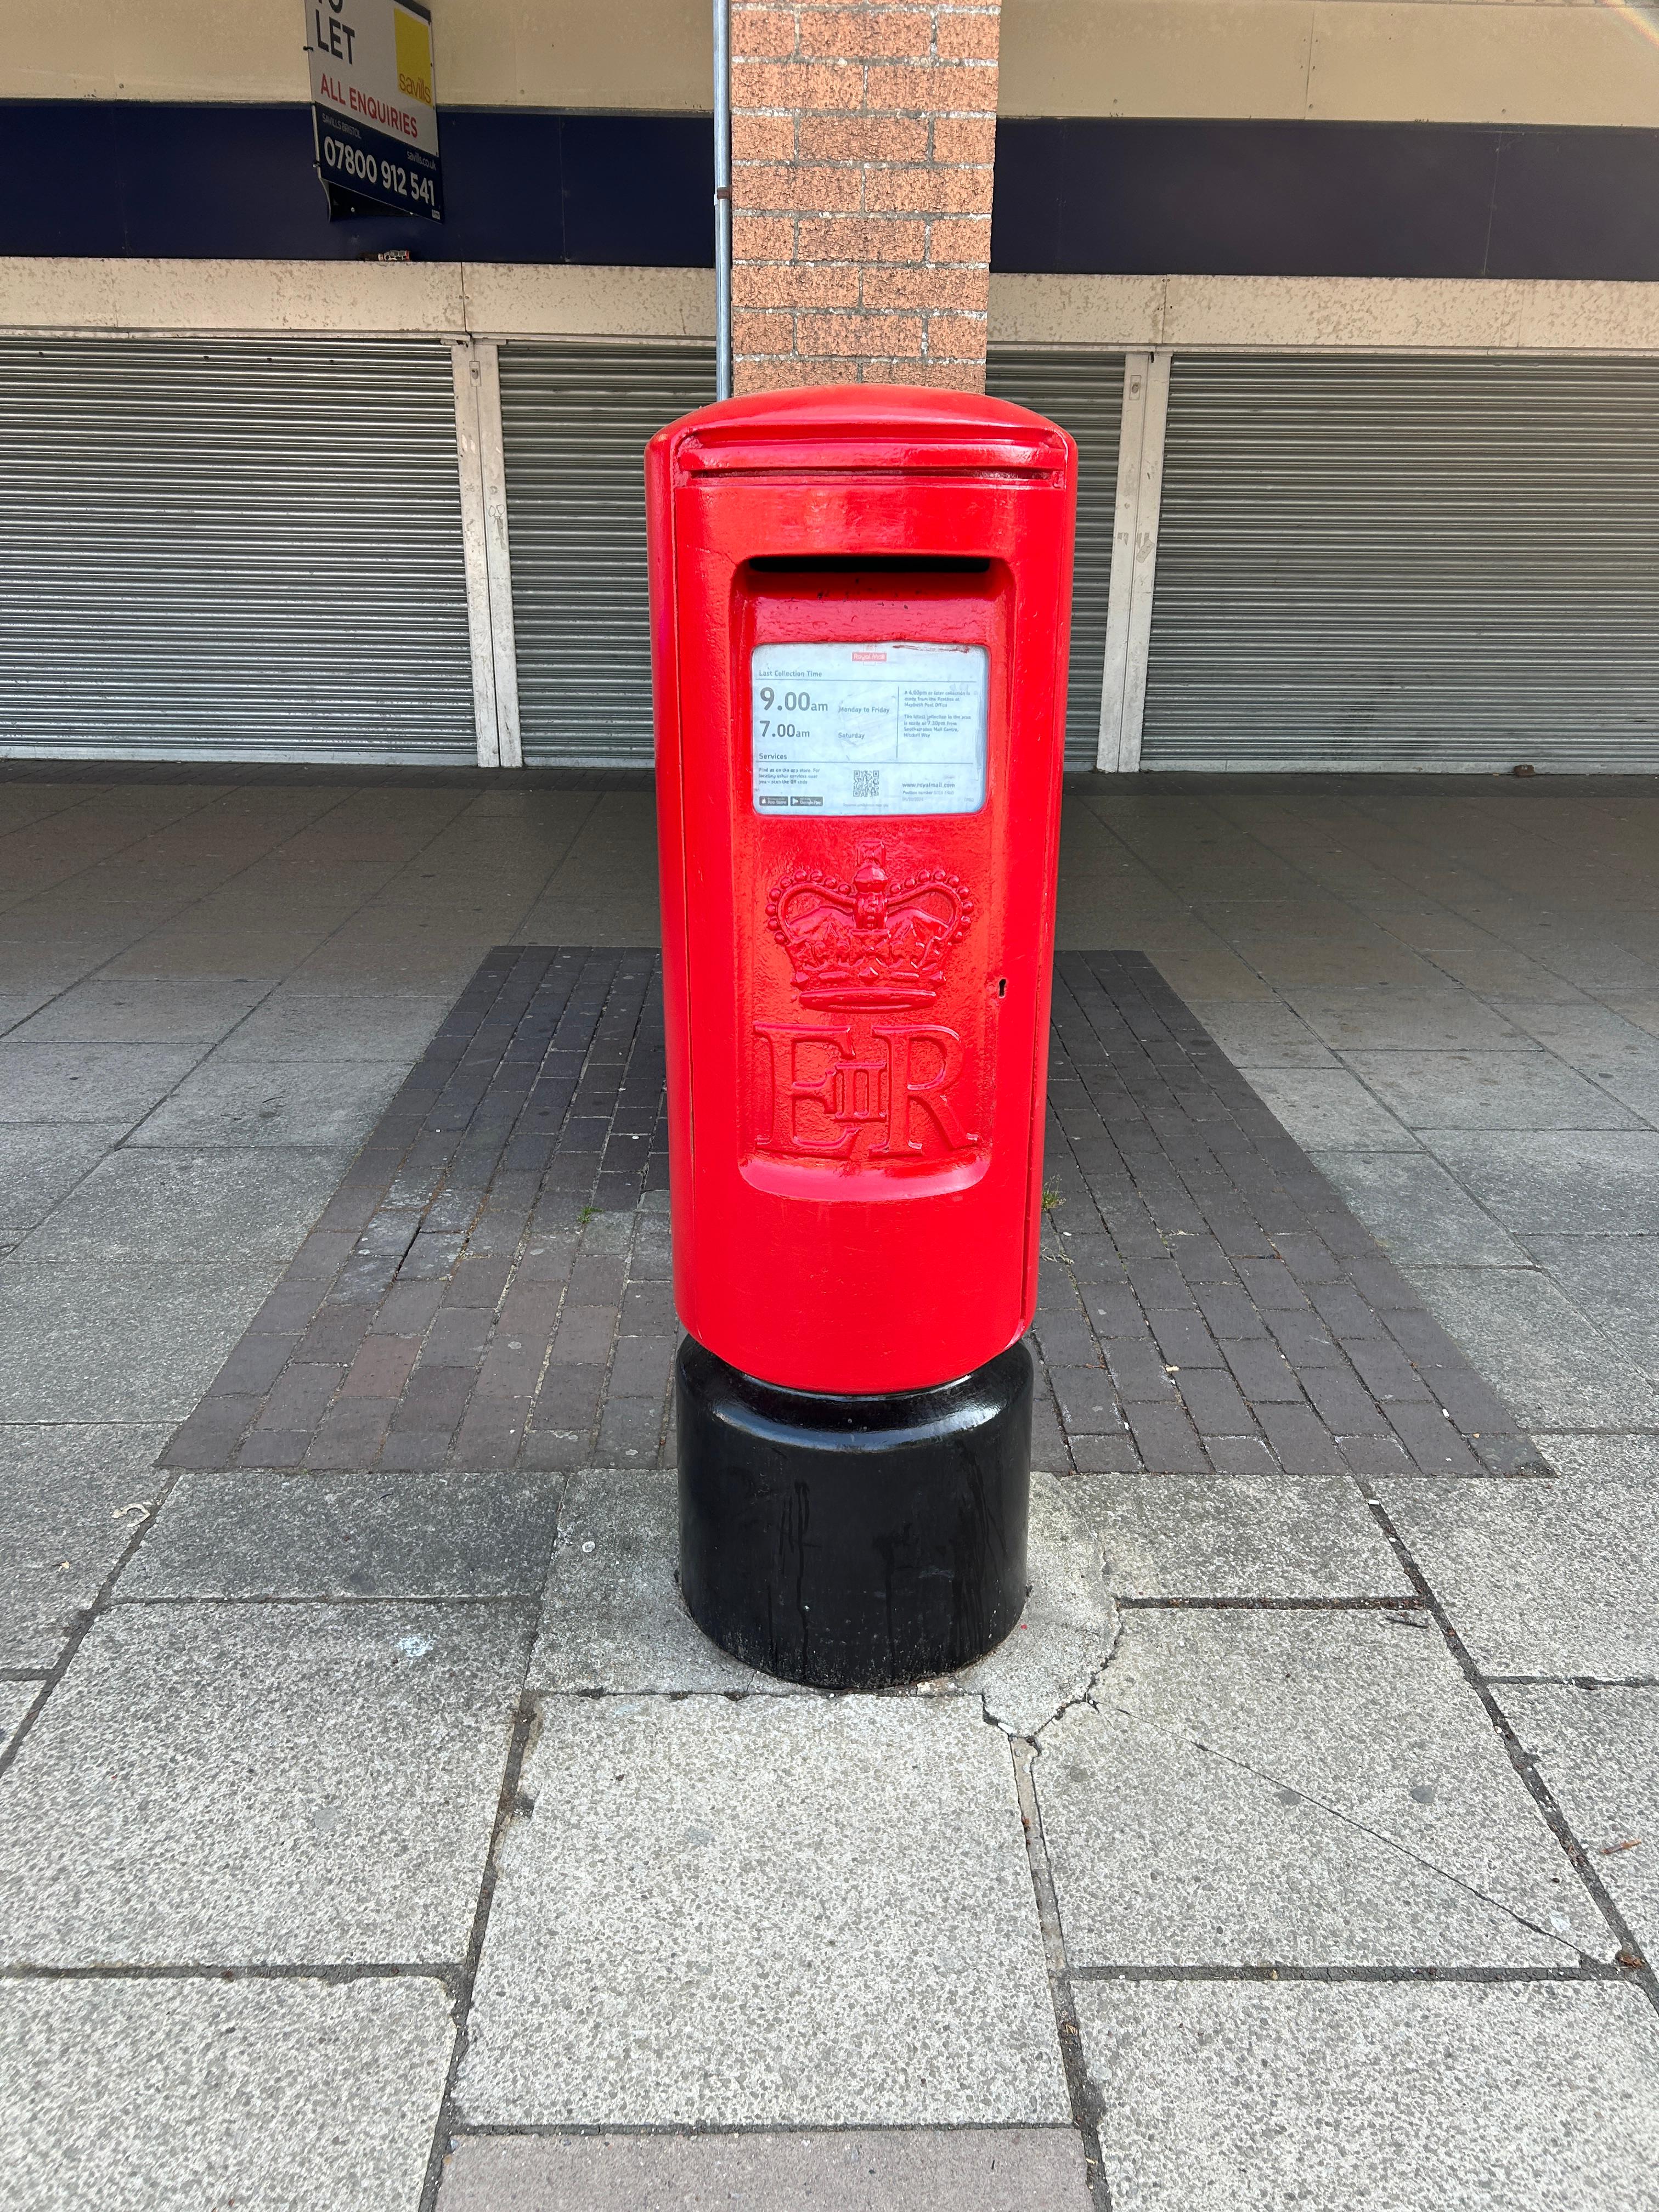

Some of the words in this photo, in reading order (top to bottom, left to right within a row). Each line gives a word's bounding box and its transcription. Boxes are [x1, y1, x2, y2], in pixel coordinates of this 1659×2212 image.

[315, 9, 355, 64] LET
[399, 74, 431, 104] savills
[320, 74, 346, 105] ALL
[350, 87, 417, 138] ENQUIRIES
[322, 113, 341, 130] SAVILLS
[341, 122, 362, 139] BRISTOL
[324, 136, 377, 183] 07800
[381, 160, 407, 195] 912
[410, 172, 435, 206] 541
[407, 151, 436, 170] savills.co.uk
[760, 687, 828, 712] 9.00am
[759, 720, 810, 737] 7.00am
